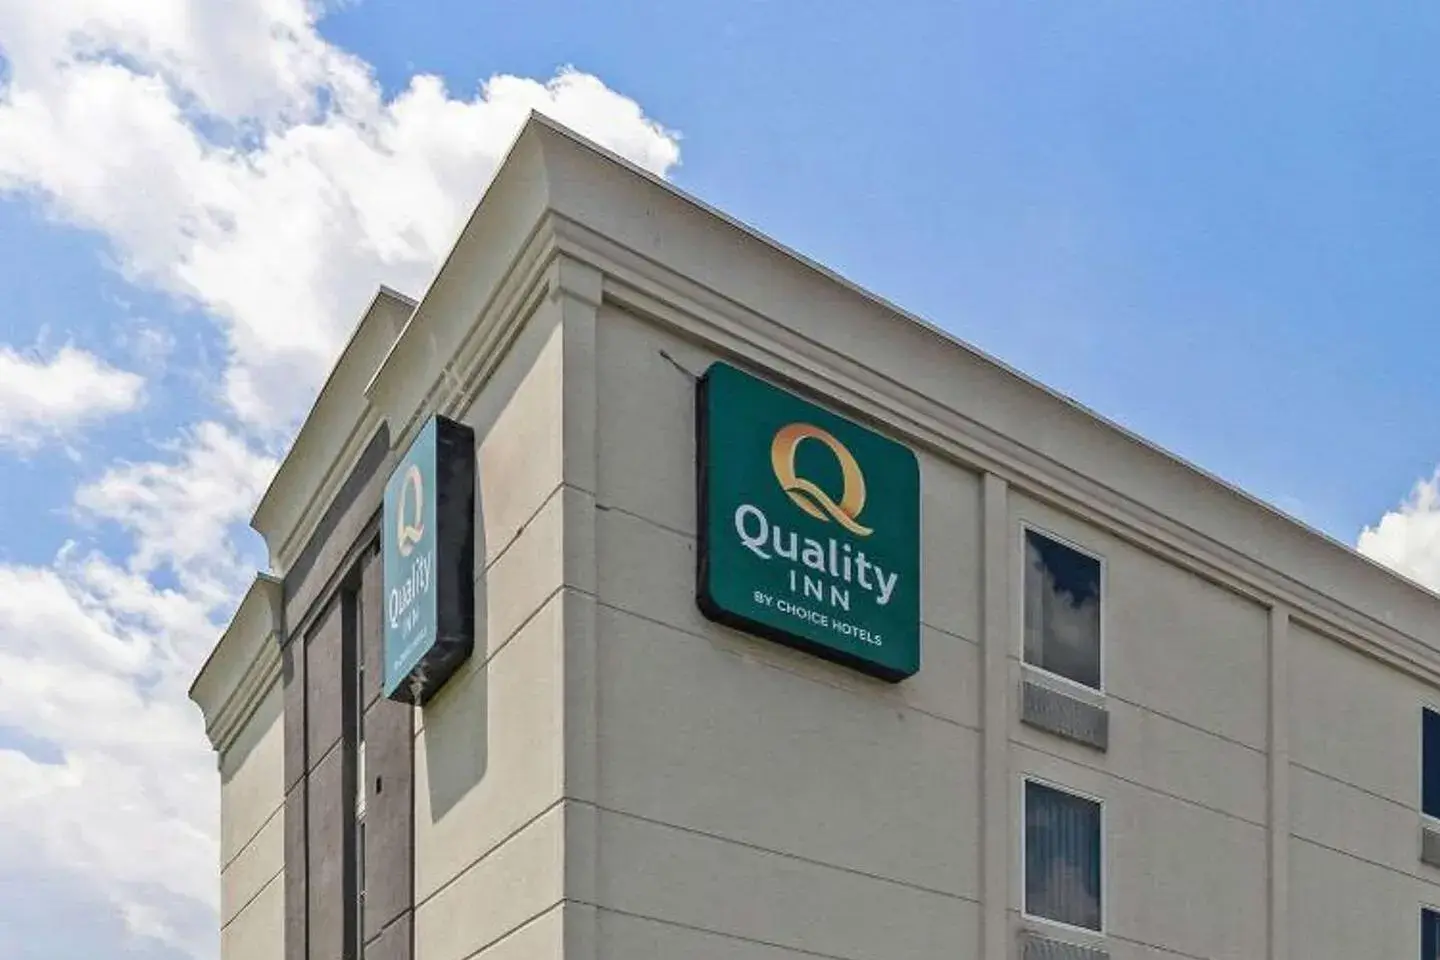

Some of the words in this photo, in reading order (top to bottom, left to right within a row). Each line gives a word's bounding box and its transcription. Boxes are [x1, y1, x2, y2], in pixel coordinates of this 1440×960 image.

[771, 422, 874, 536] Q
[389, 551, 431, 629] Quality
[734, 504, 898, 606] Quality
[789, 569, 850, 611] INN
[753, 590, 773, 606] BY
[776, 599, 829, 627] CHOICE
[832, 619, 882, 647] HOTELS
